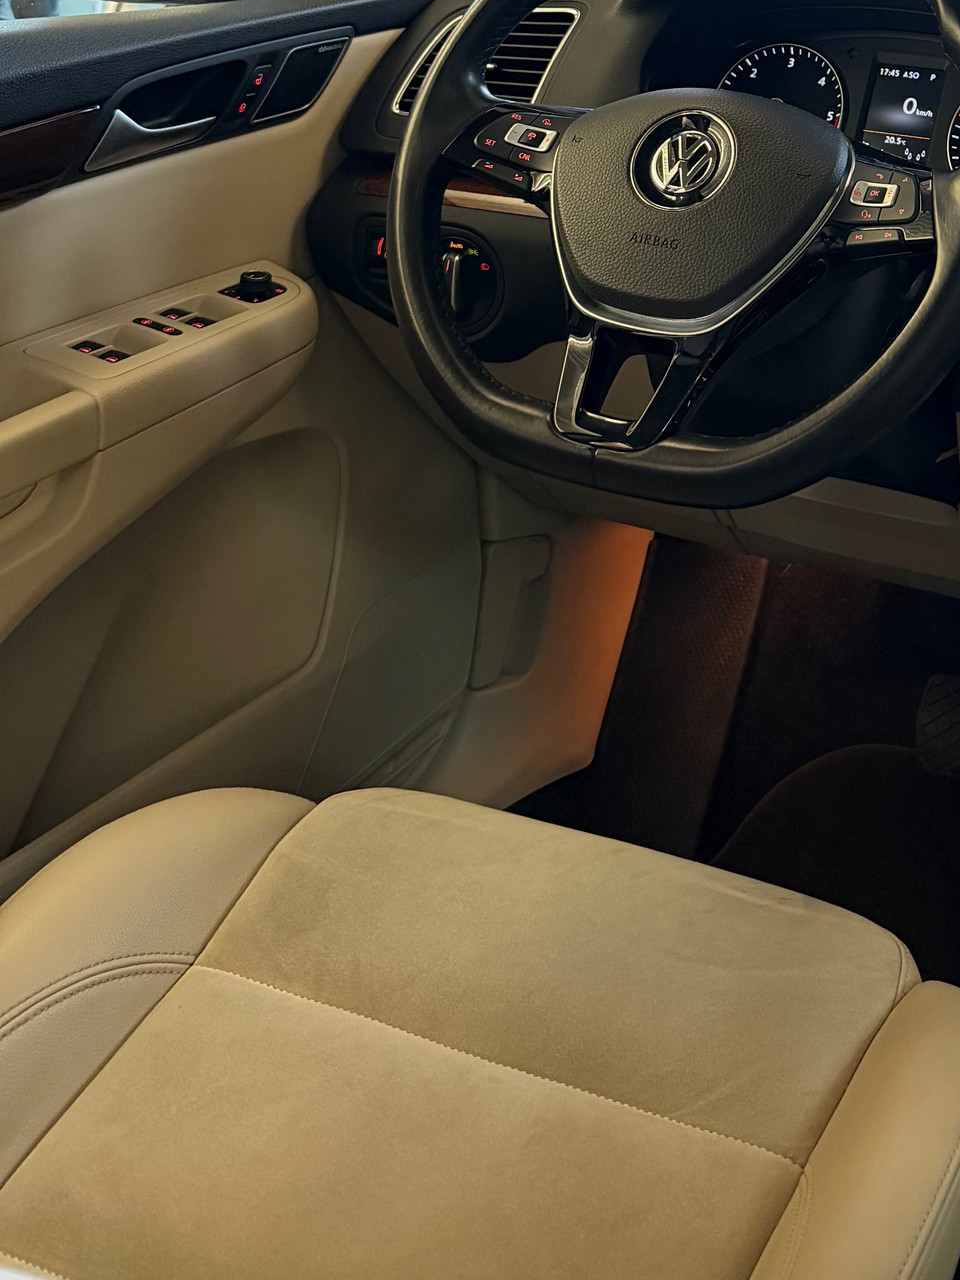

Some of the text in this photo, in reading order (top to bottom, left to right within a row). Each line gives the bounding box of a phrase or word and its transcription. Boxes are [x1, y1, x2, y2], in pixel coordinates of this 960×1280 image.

[787, 58, 795, 68] 3
[750, 68, 758, 78] 2
[880, 68, 900, 78] 17:45
[929, 73, 936, 81] P
[817, 76, 826, 87] 4
[902, 97, 933, 117] 0 km/h
[826, 111, 834, 121] 5
[484, 138, 497, 147] SET
[629, 231, 679, 250] AIRBAG
